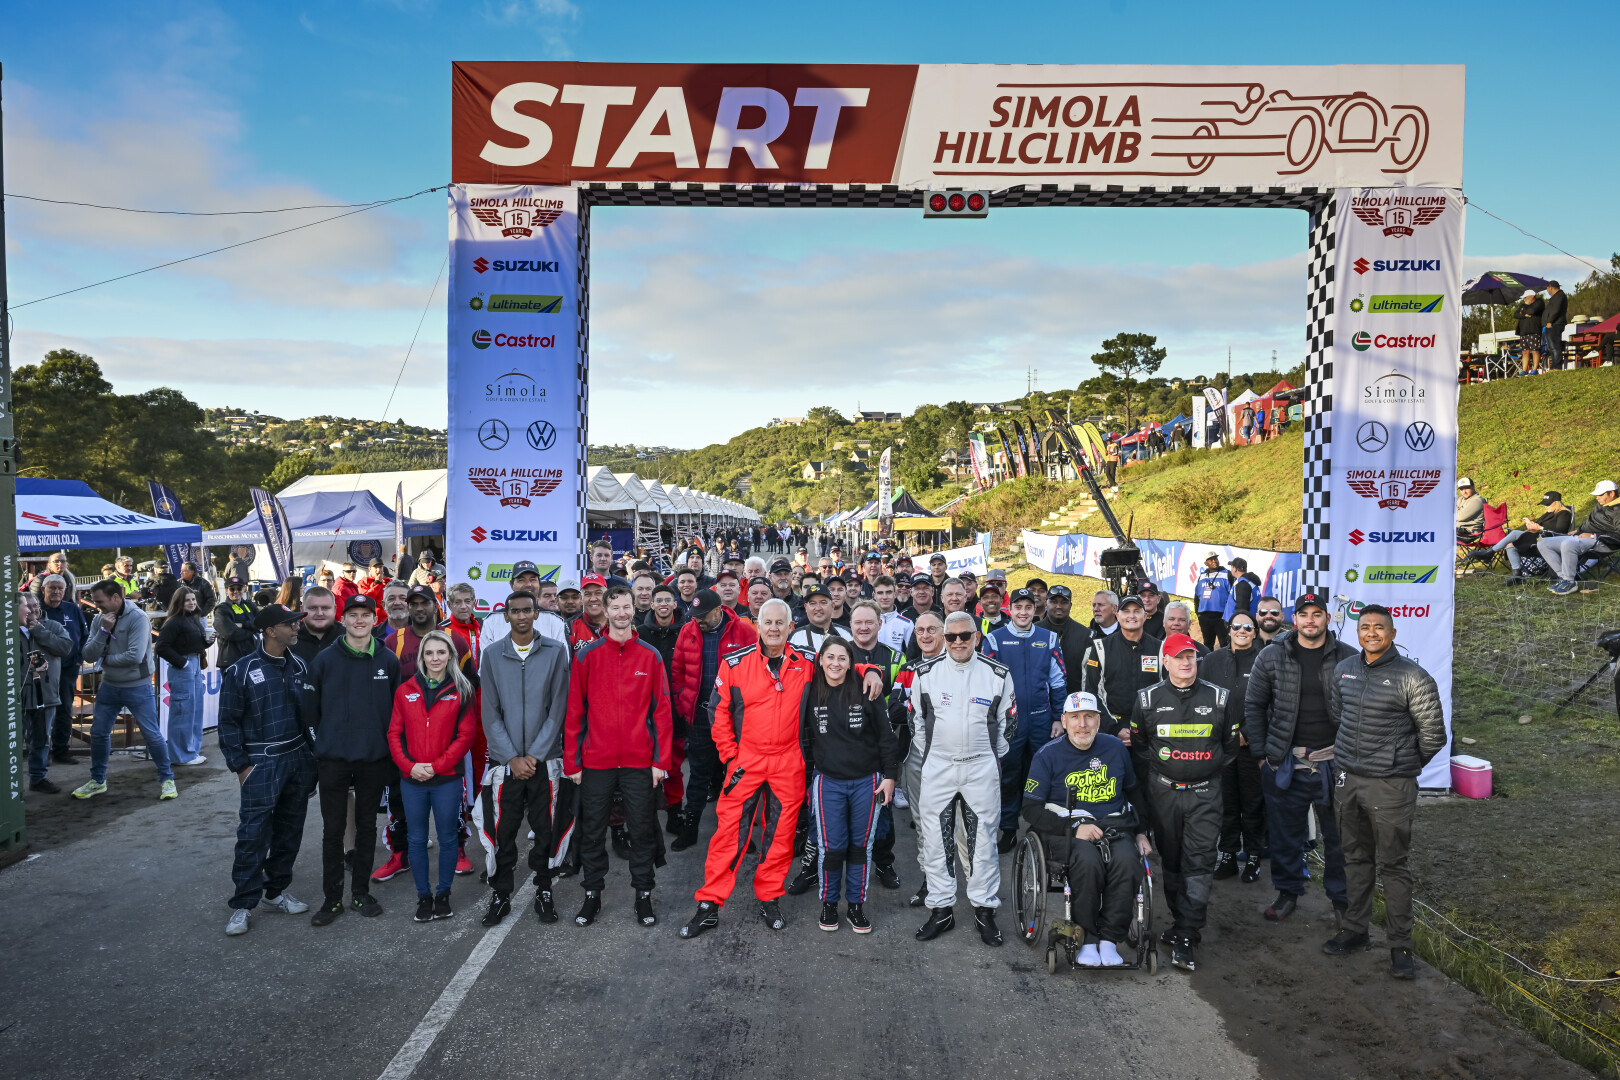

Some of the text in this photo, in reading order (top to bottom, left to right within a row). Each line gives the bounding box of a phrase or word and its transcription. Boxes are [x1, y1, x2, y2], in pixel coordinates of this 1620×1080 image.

[989, 95, 1141, 128] SIMOLA
[479, 81, 870, 170] START
[933, 131, 1141, 164] HILLCLIMB
[469, 197, 564, 209] SIMOLA HILLCLIMB
[1351, 196, 1446, 206] SIMOLA HILLCLIMB
[511, 212, 523, 226] 15
[1392, 211, 1404, 225] 15
[492, 260, 559, 273] SUZUKI
[1373, 259, 1440, 271] SUZUKI
[492, 299, 541, 311] ultimate
[1373, 299, 1422, 311] ultimate
[494, 333, 555, 348] Castrol
[1374, 334, 1436, 348] Castrol
[486, 384, 546, 397] Simola
[1364, 385, 1425, 398] Simola
[468, 467, 563, 478] SIMOLA HILLCLIMB
[1346, 469, 1441, 479] SIMOLA HILLCLIMB
[509, 482, 521, 496] 15
[1388, 485, 1399, 497] 15
[52, 514, 156, 526] SUZUKI
[18, 534, 80, 547] WWW.SUZUKI.CO.ZA
[490, 529, 558, 542] SUZUKI
[1368, 531, 1435, 543] SUZUKI
[1152, 546, 1176, 582] Yeah!
[1368, 570, 1416, 581] ultimate
[1383, 604, 1430, 618] astrol
[3, 555, 18, 799] WWW.VALLEYCONTAINERS.CO.ZA
[1171, 749, 1212, 760] Castrol
[1076, 777, 1117, 803] Head
